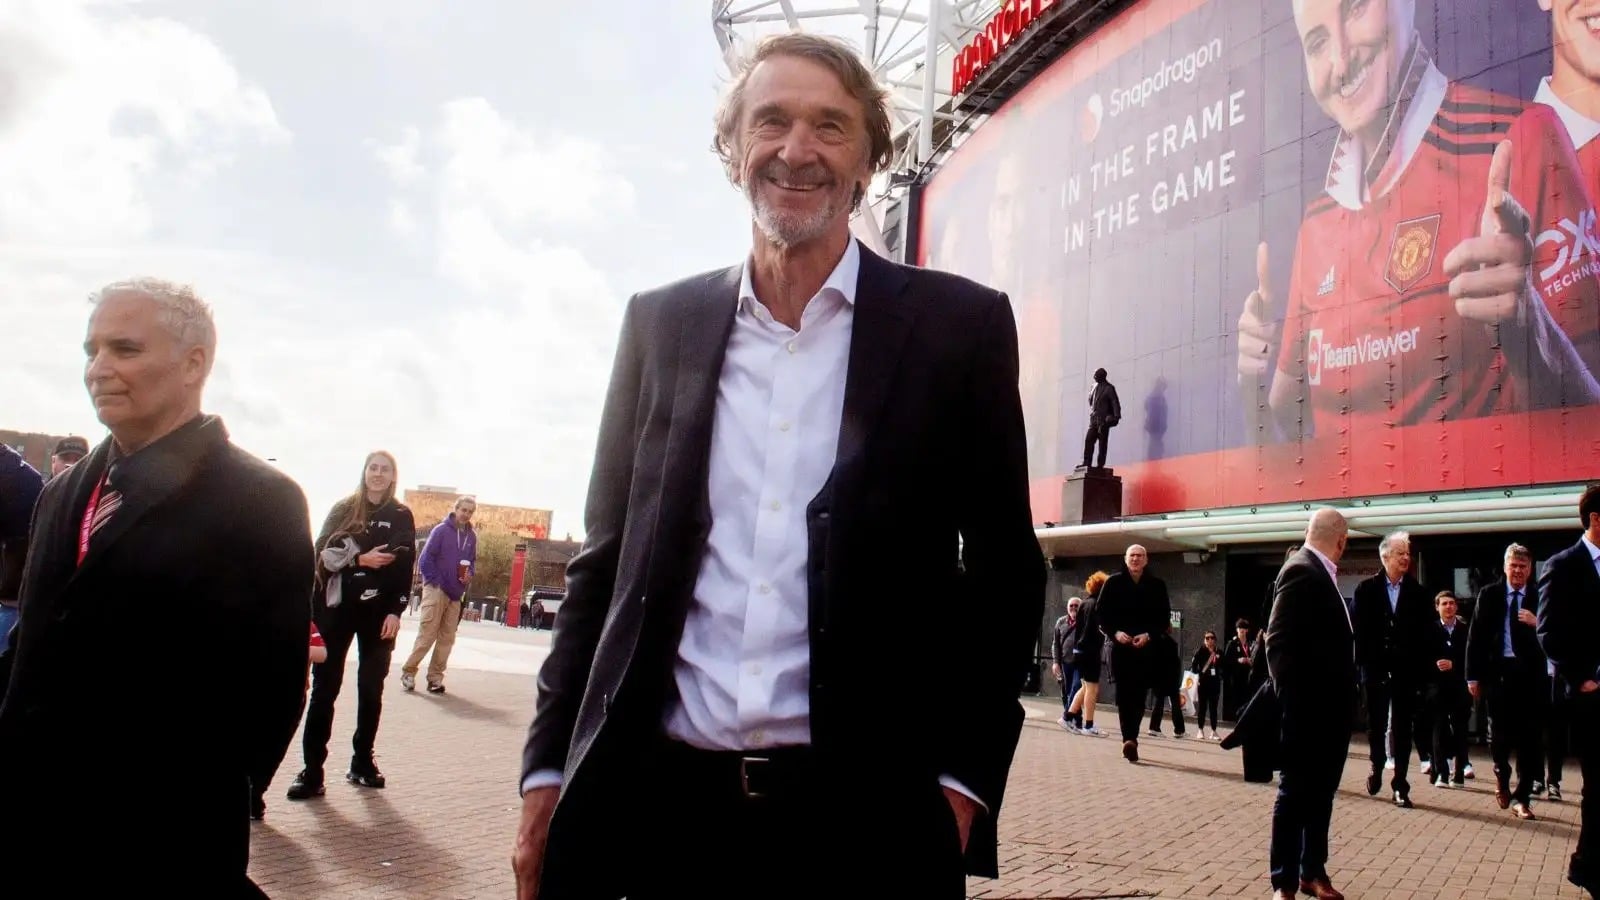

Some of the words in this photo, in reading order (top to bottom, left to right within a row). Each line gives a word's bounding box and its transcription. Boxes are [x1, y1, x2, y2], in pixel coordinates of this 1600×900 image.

[1109, 38, 1222, 117] Snapdragon
[1061, 174, 1081, 209] IN
[1090, 145, 1135, 192] THE
[1146, 89, 1246, 165] FRAME
[1064, 219, 1084, 254] IN
[1094, 193, 1140, 239] THE
[1151, 150, 1236, 214] GAME
[1322, 326, 1420, 369] TeamViewer
